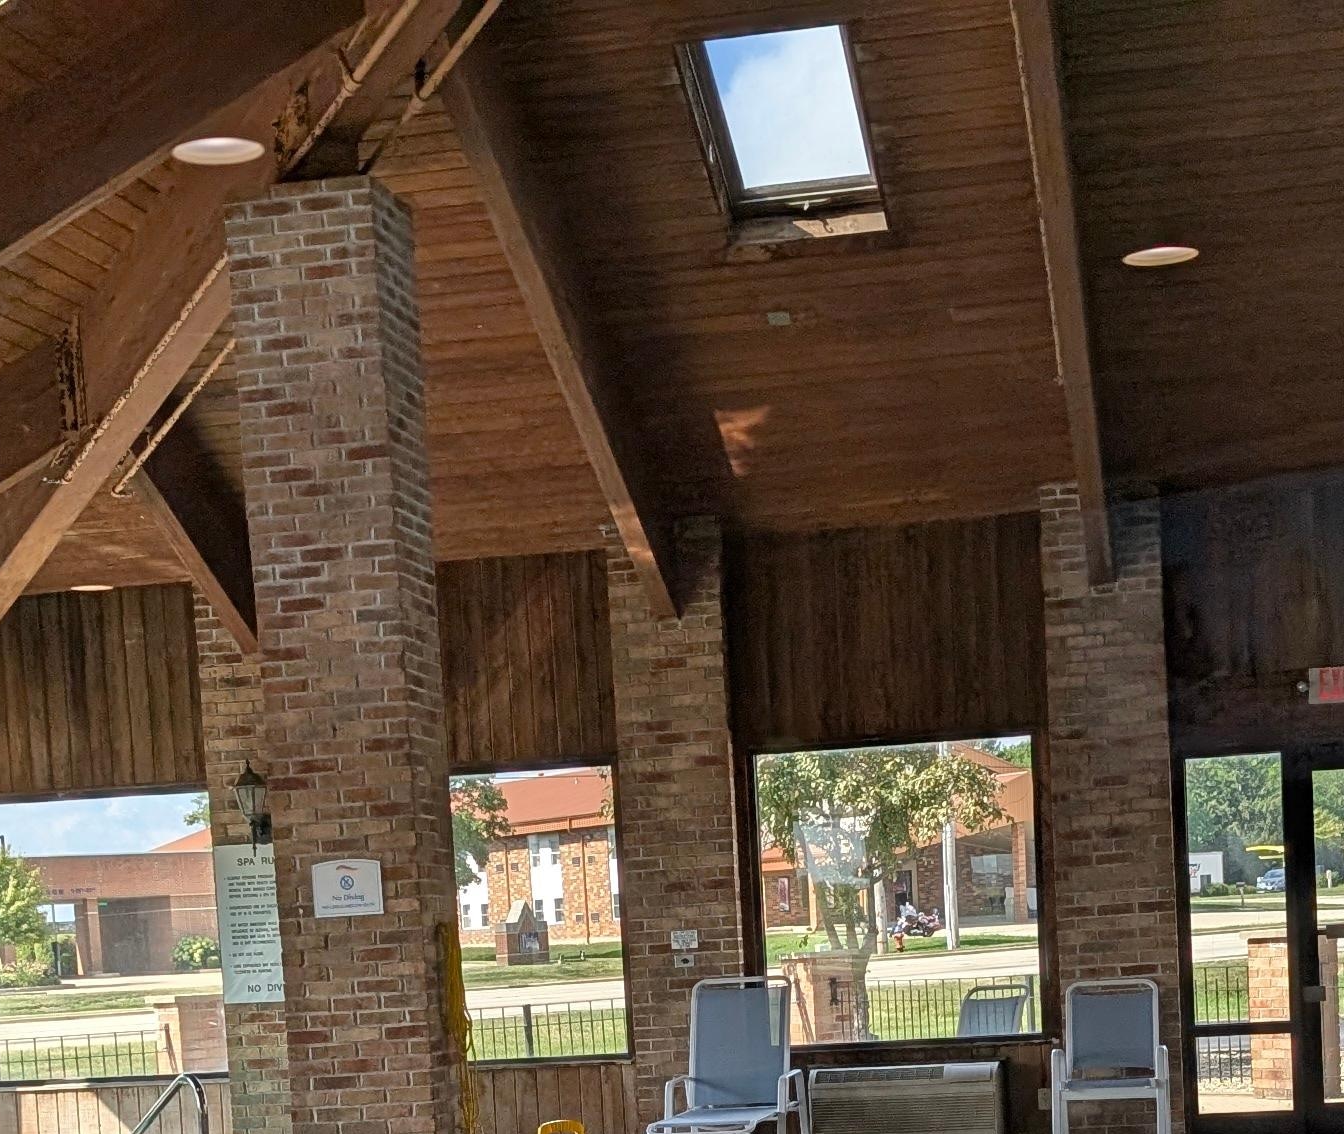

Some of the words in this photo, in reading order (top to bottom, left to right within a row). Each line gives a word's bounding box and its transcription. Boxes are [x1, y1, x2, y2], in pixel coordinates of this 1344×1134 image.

[236, 857, 255, 867] SPA
[247, 984, 262, 993] NO
[267, 983, 283, 992] DIV
